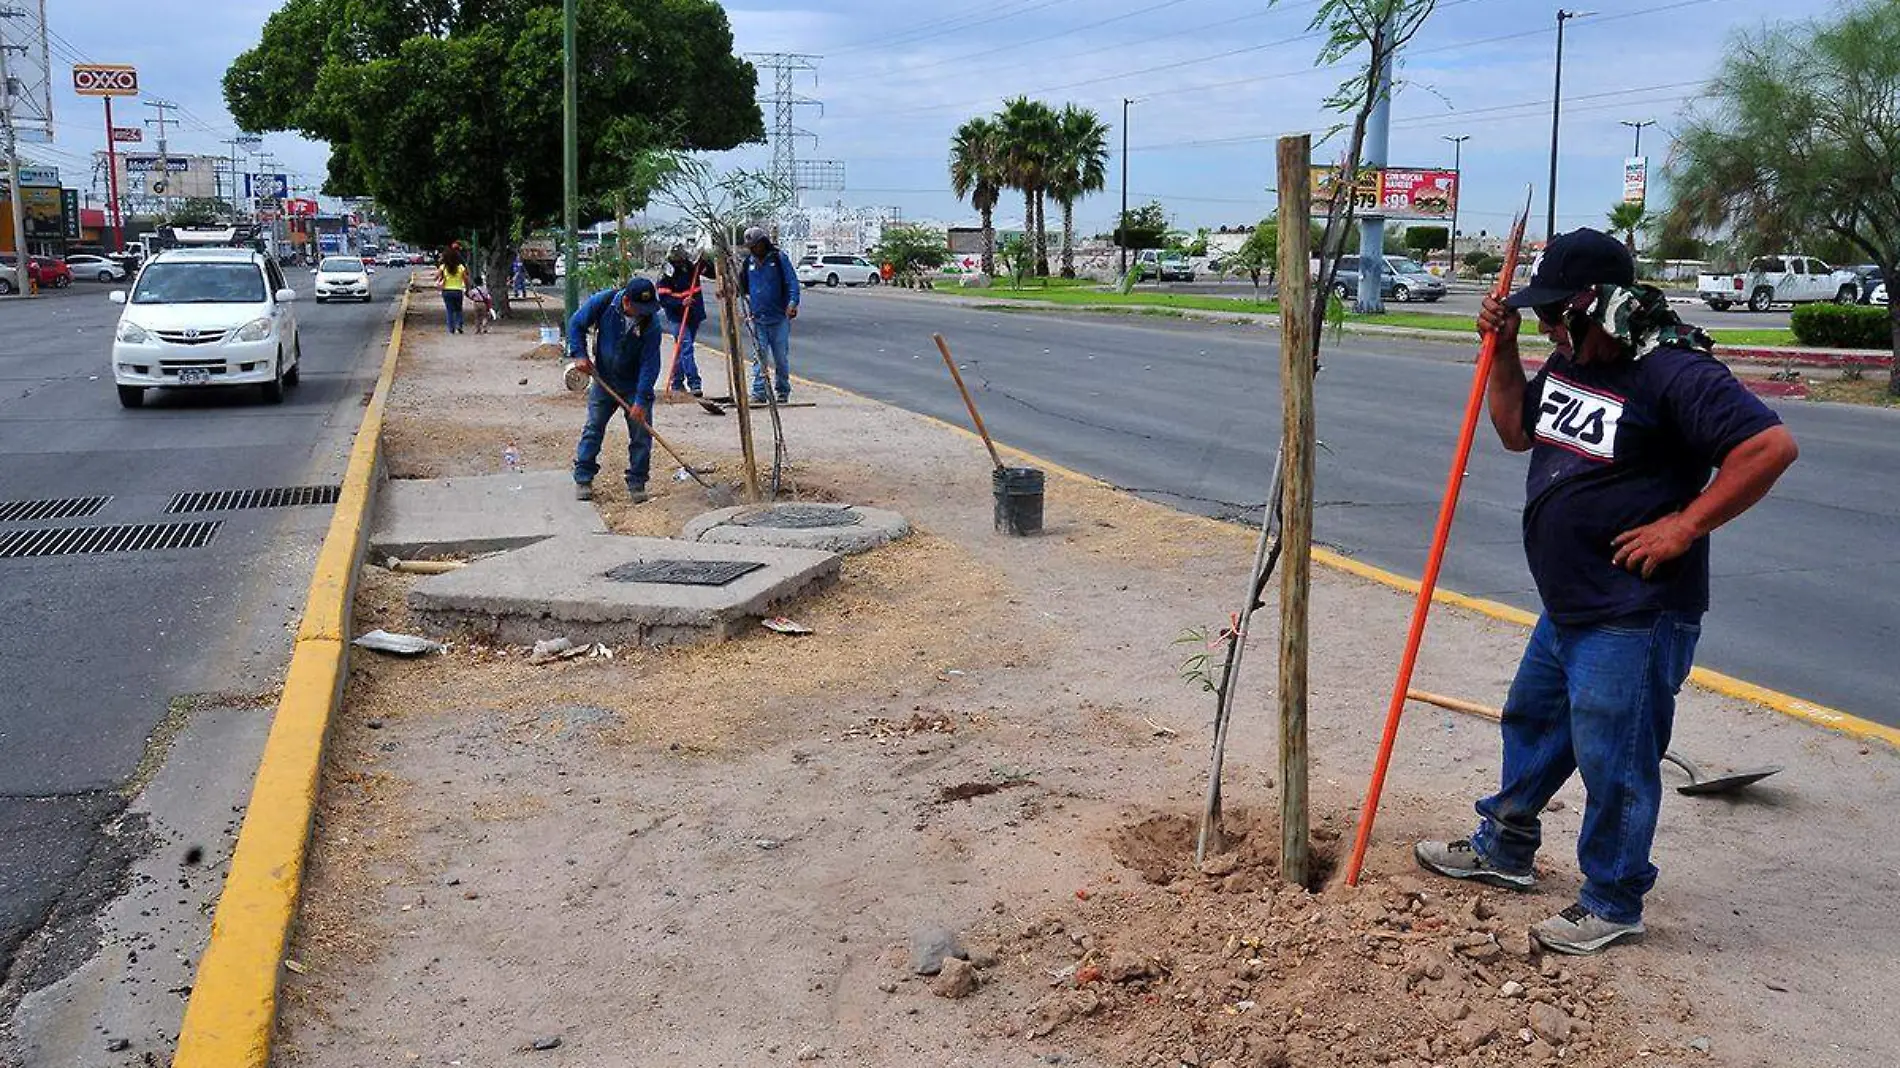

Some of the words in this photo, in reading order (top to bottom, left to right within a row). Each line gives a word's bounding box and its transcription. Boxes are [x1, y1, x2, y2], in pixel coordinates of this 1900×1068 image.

[75, 70, 134, 89] OXXO
[1384, 194, 1409, 208] $99
[1541, 390, 1606, 445] FILA
